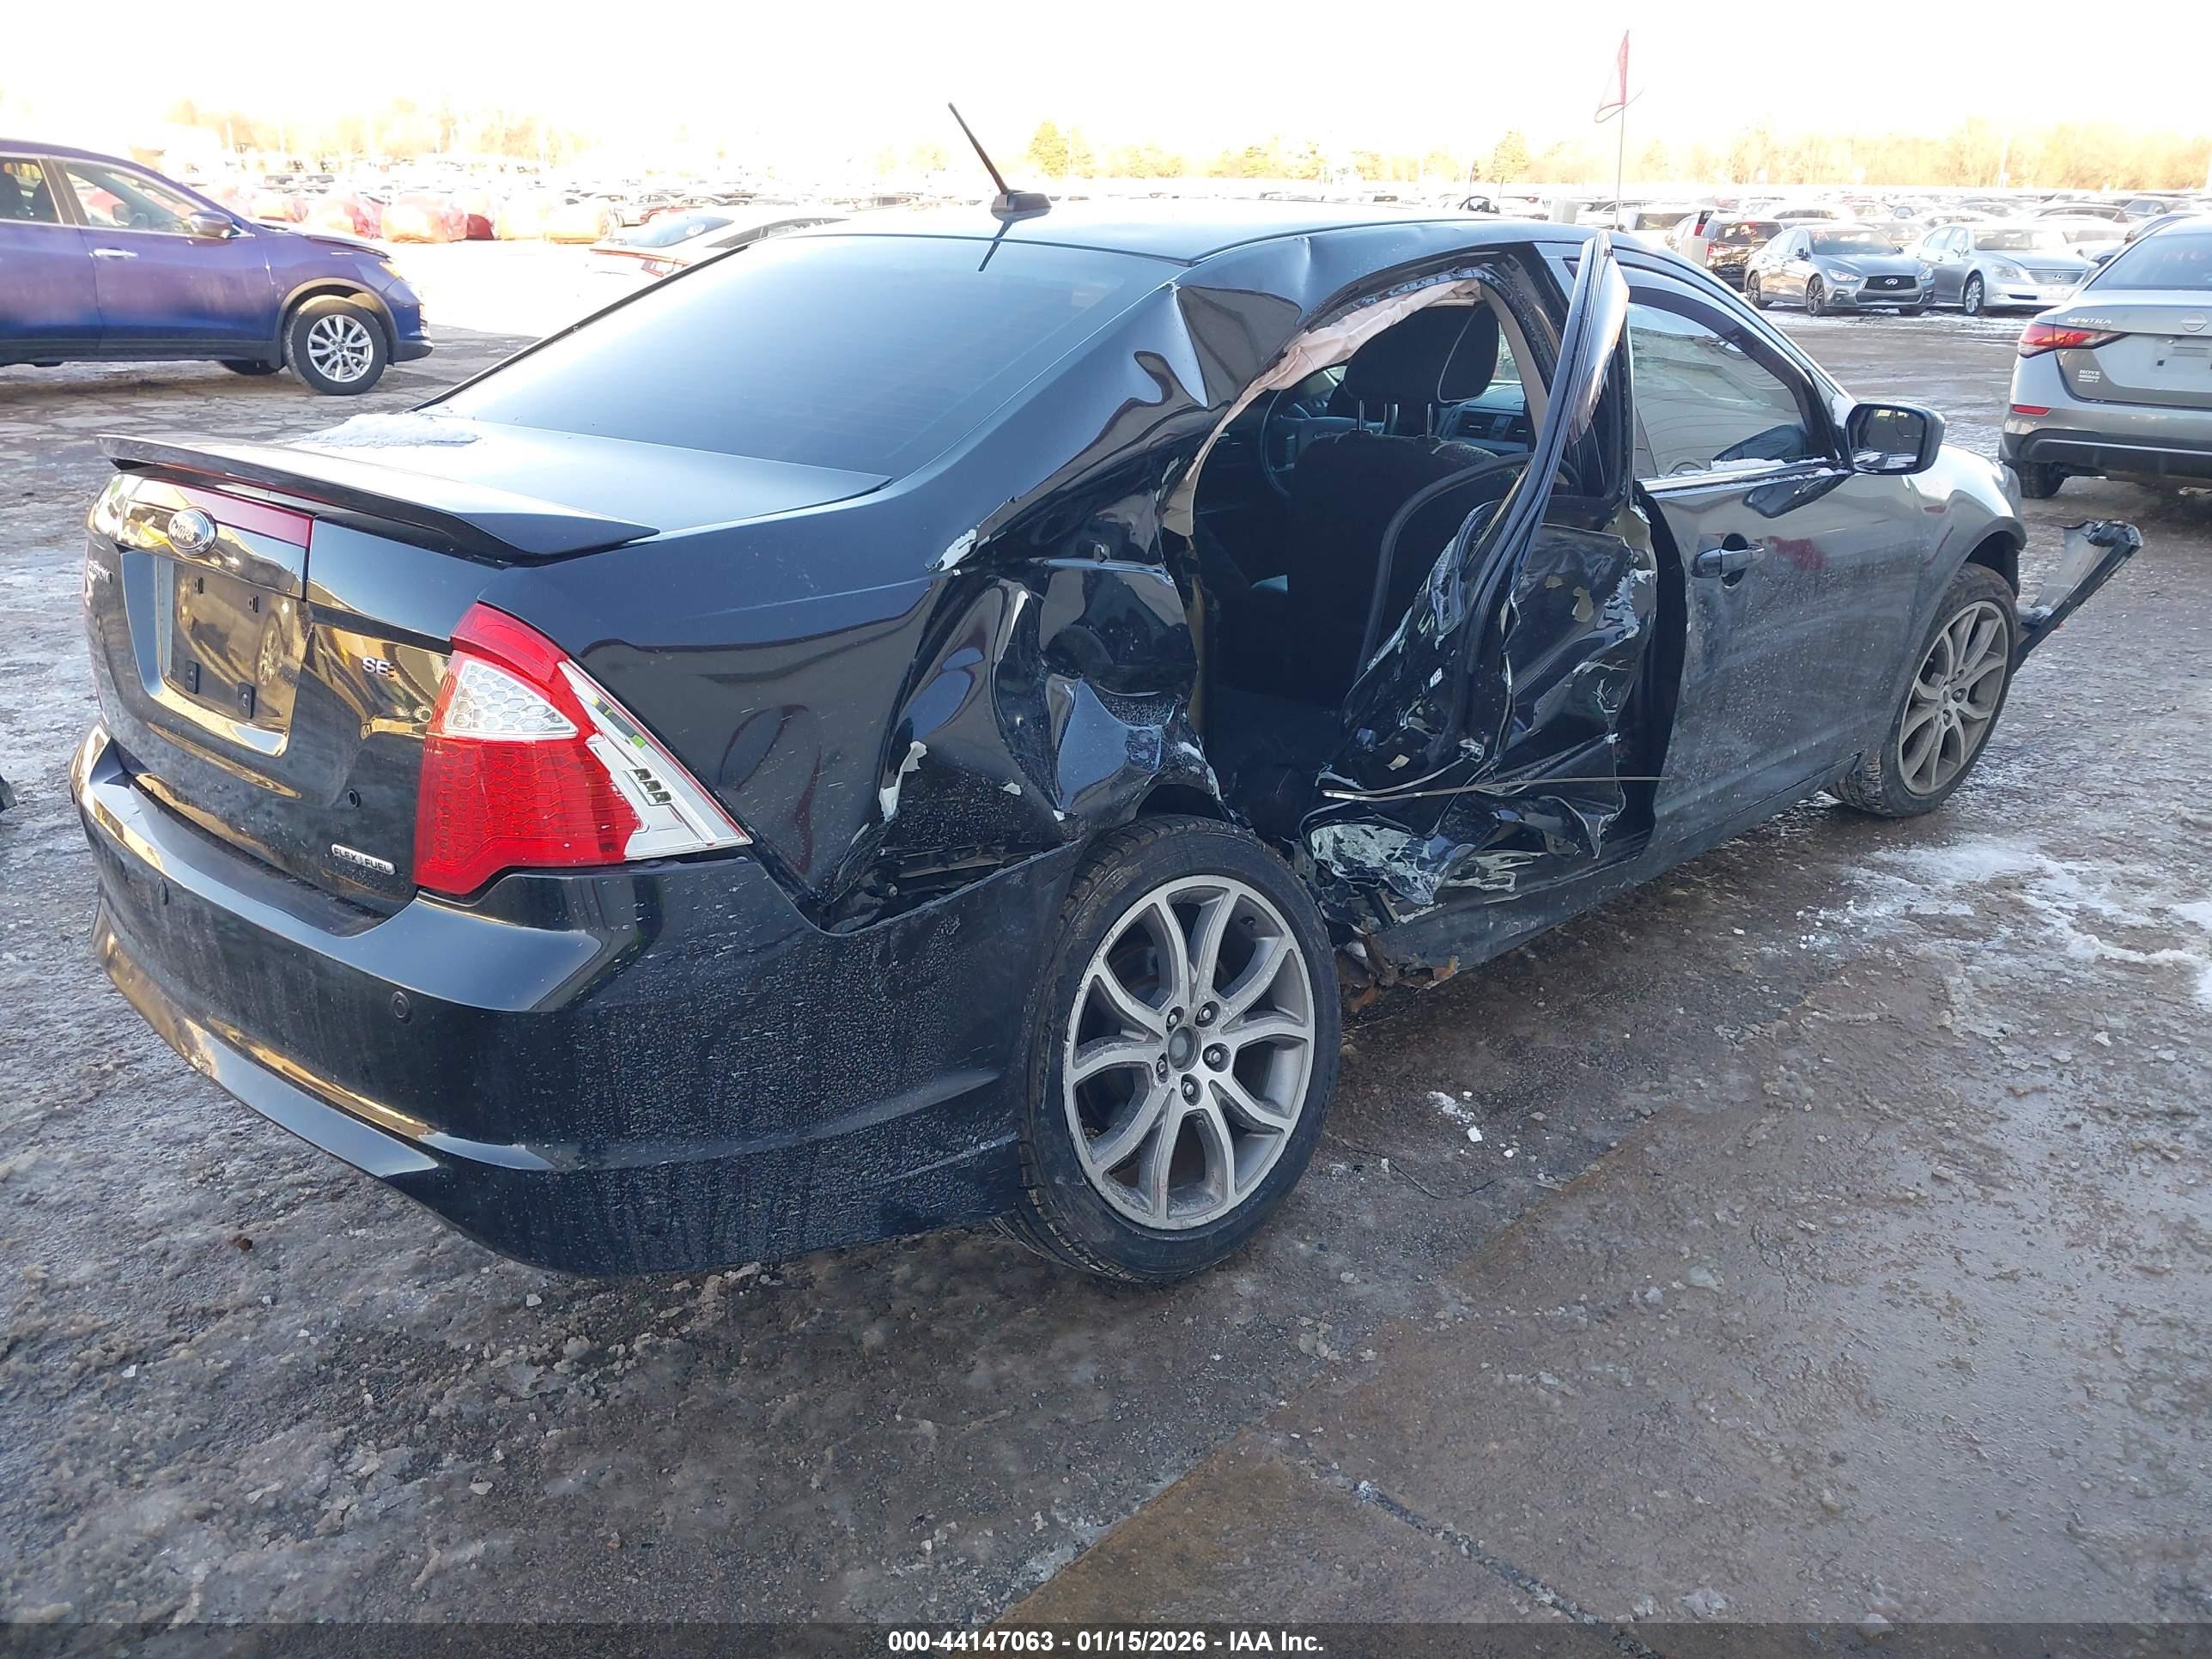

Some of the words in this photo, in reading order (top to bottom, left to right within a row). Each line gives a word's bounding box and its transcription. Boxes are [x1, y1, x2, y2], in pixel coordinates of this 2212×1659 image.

[2067, 316, 2112, 325] SENTRA
[362, 657, 392, 678] SE
[333, 847, 358, 862] FLEX
[364, 858, 392, 872] FUEL
